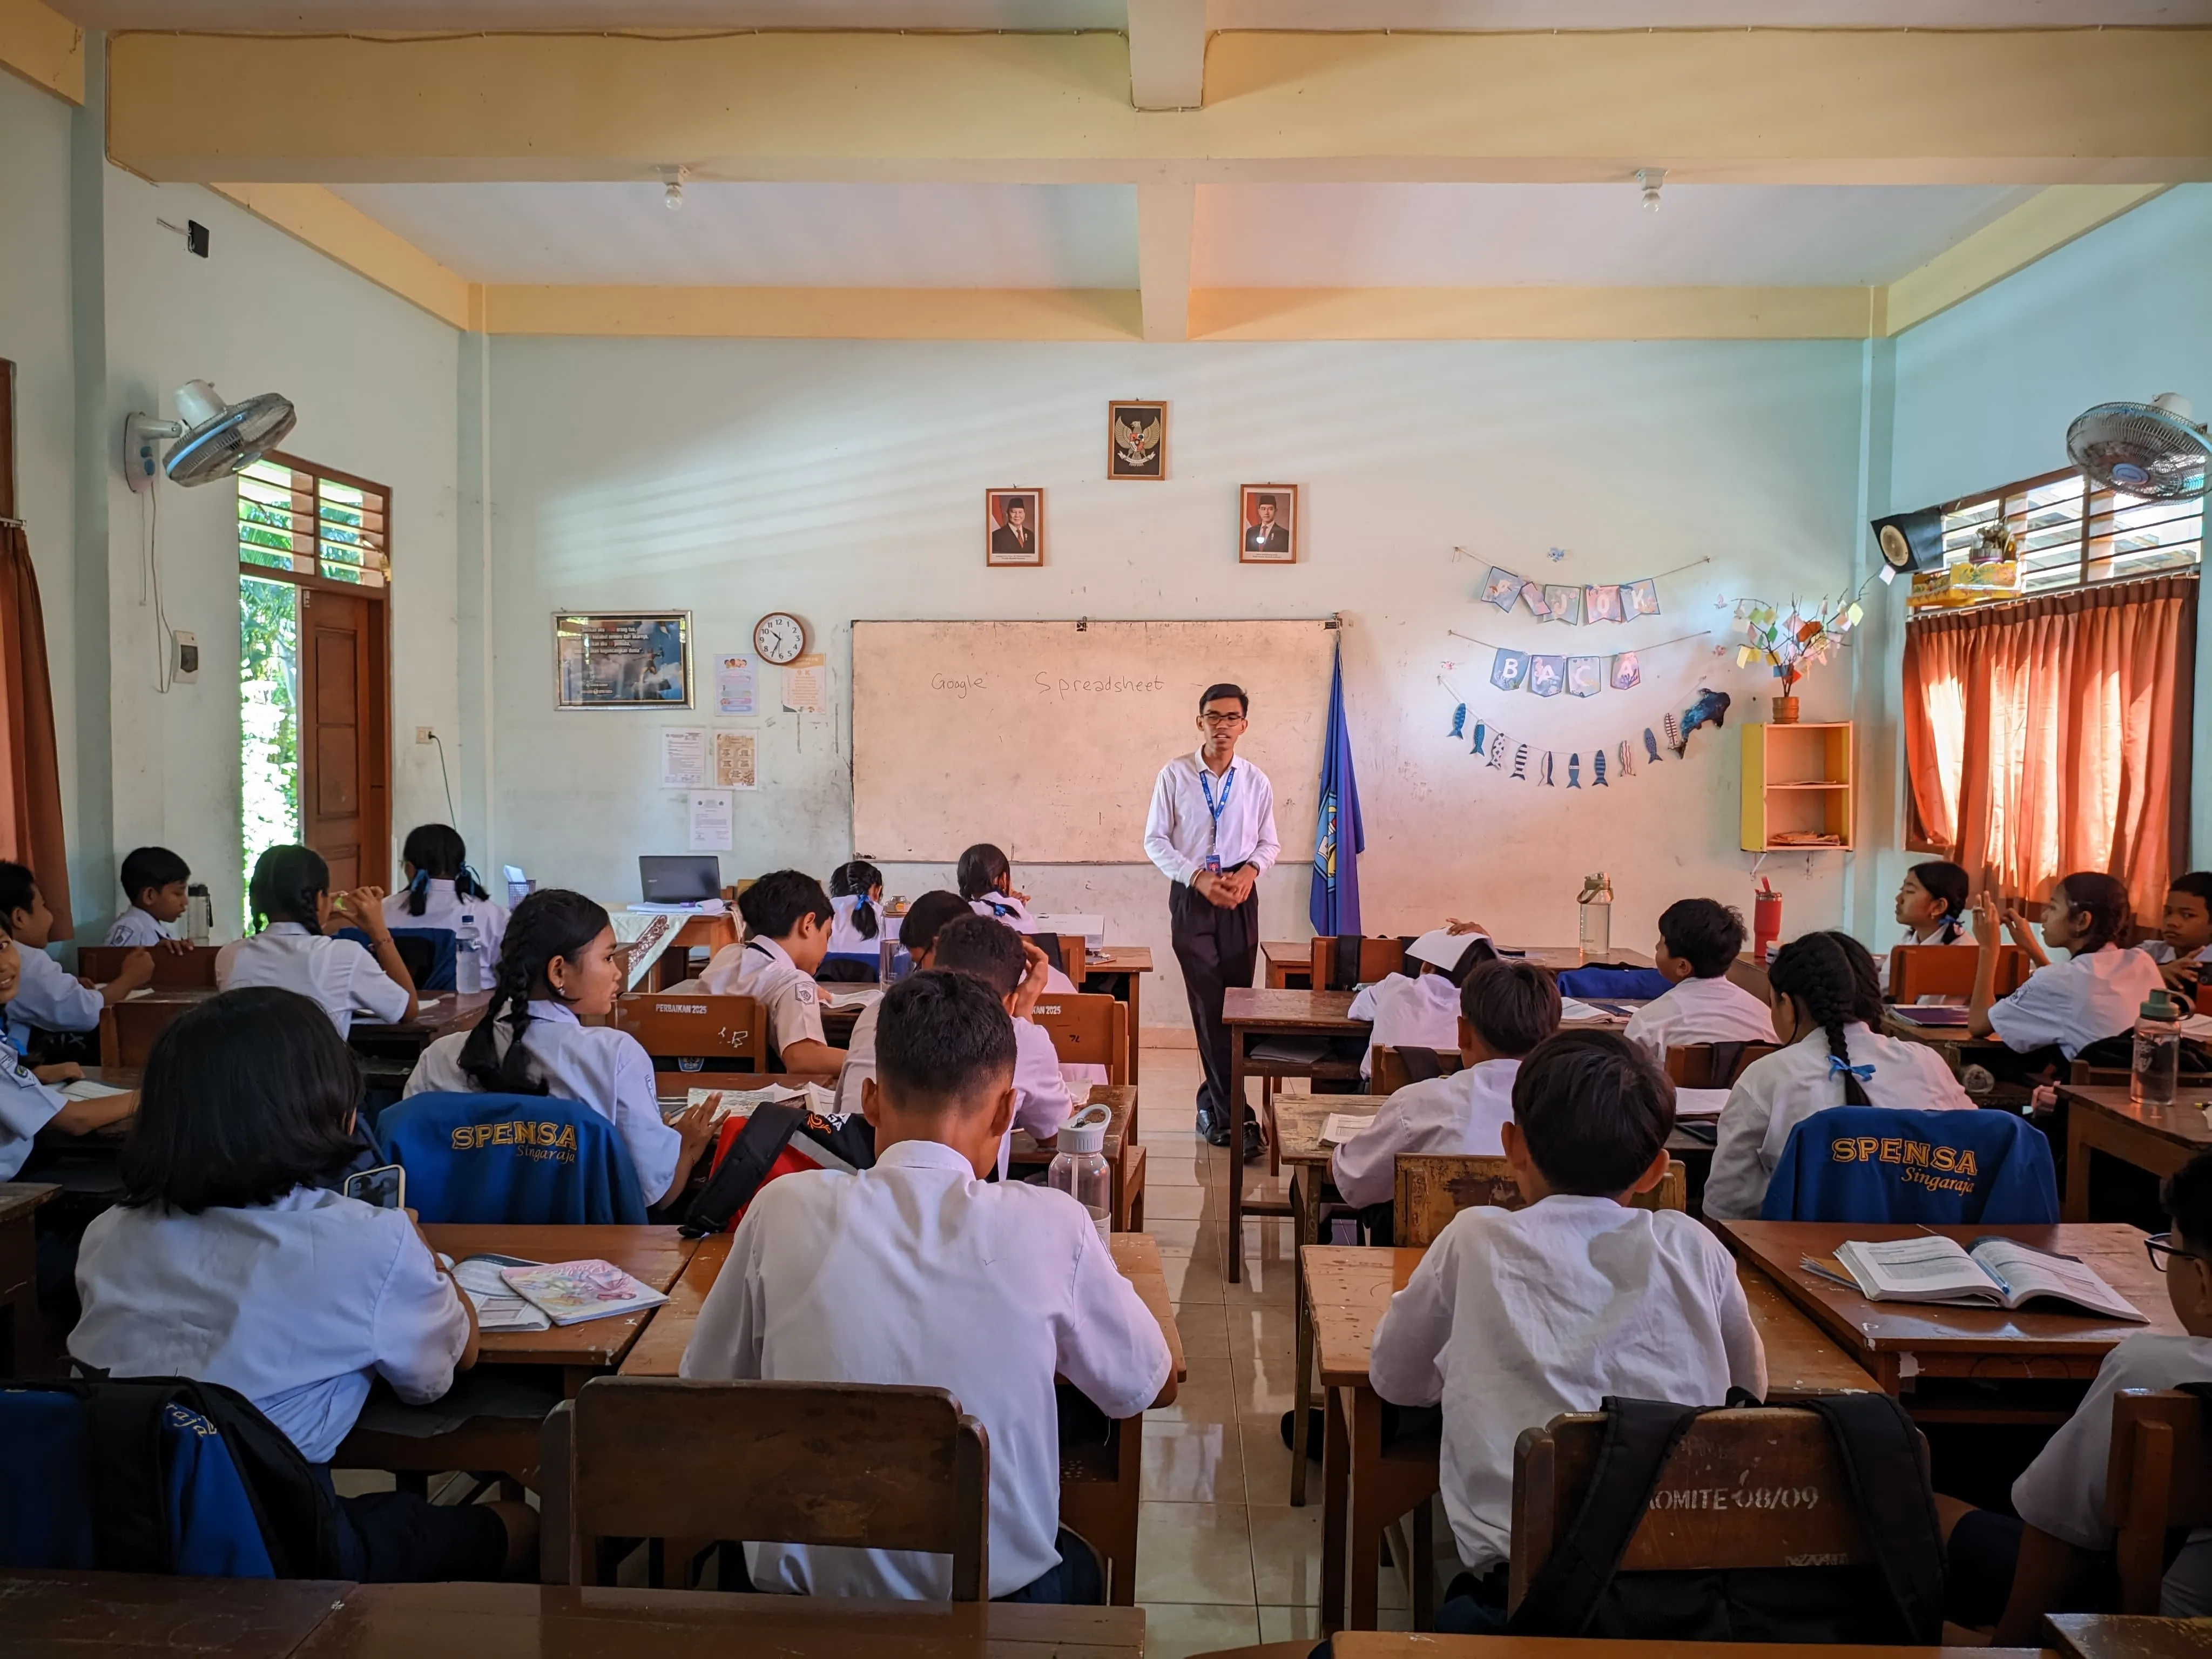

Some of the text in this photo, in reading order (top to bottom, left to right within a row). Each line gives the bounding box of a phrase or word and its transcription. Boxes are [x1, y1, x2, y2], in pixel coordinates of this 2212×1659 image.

[932, 671, 1164, 700] Google Spreadsheet
[656, 1004, 707, 1014] PERBAIKAN 2025
[1046, 1006, 1061, 1014] 2025
[451, 1121, 577, 1150] SPENSA
[516, 1144, 576, 1164] Singaraja
[1832, 1137, 1978, 1176] SPENSA
[1900, 1166, 1975, 1197] Singaraja
[1650, 1486, 1819, 1510] OMITE 08/09
